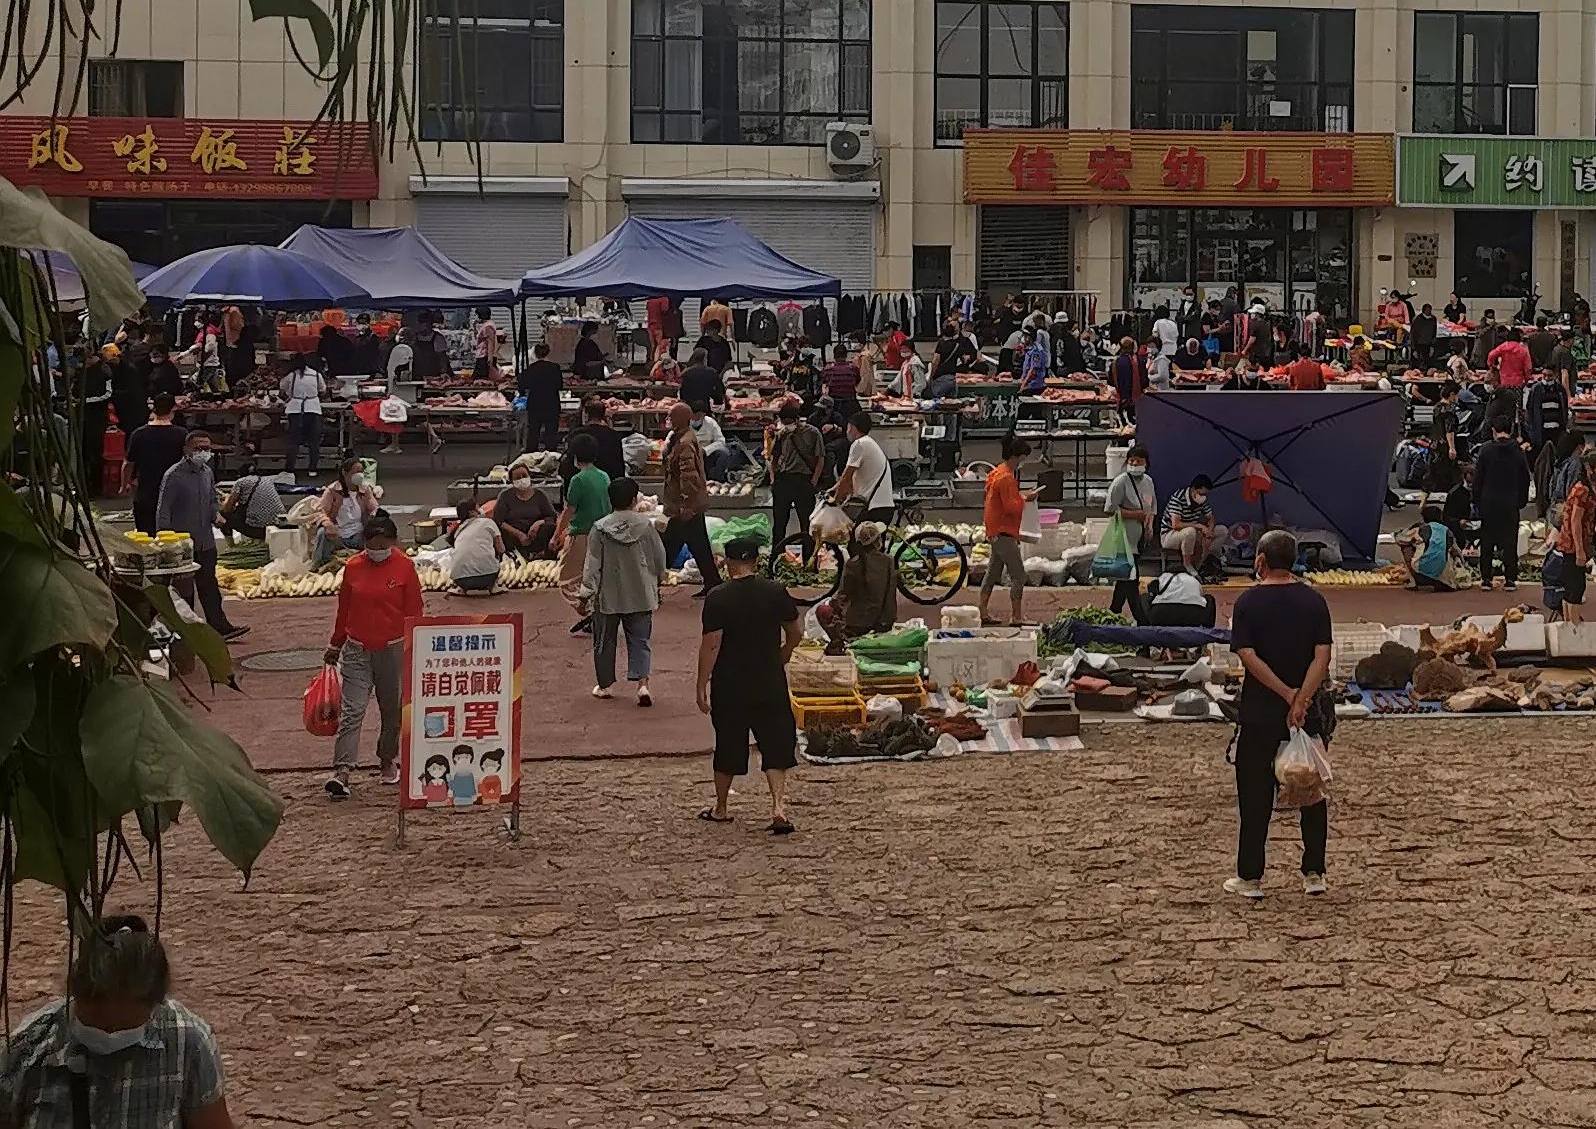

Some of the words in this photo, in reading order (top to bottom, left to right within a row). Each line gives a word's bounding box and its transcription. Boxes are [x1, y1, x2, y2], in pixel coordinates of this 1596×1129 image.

[1008, 144, 1353, 191] 佳宏幼儿园
[432, 634, 496, 651] 温馨提示
[421, 670, 502, 697] 请自觉佩戴
[424, 701, 499, 739] 口罩
